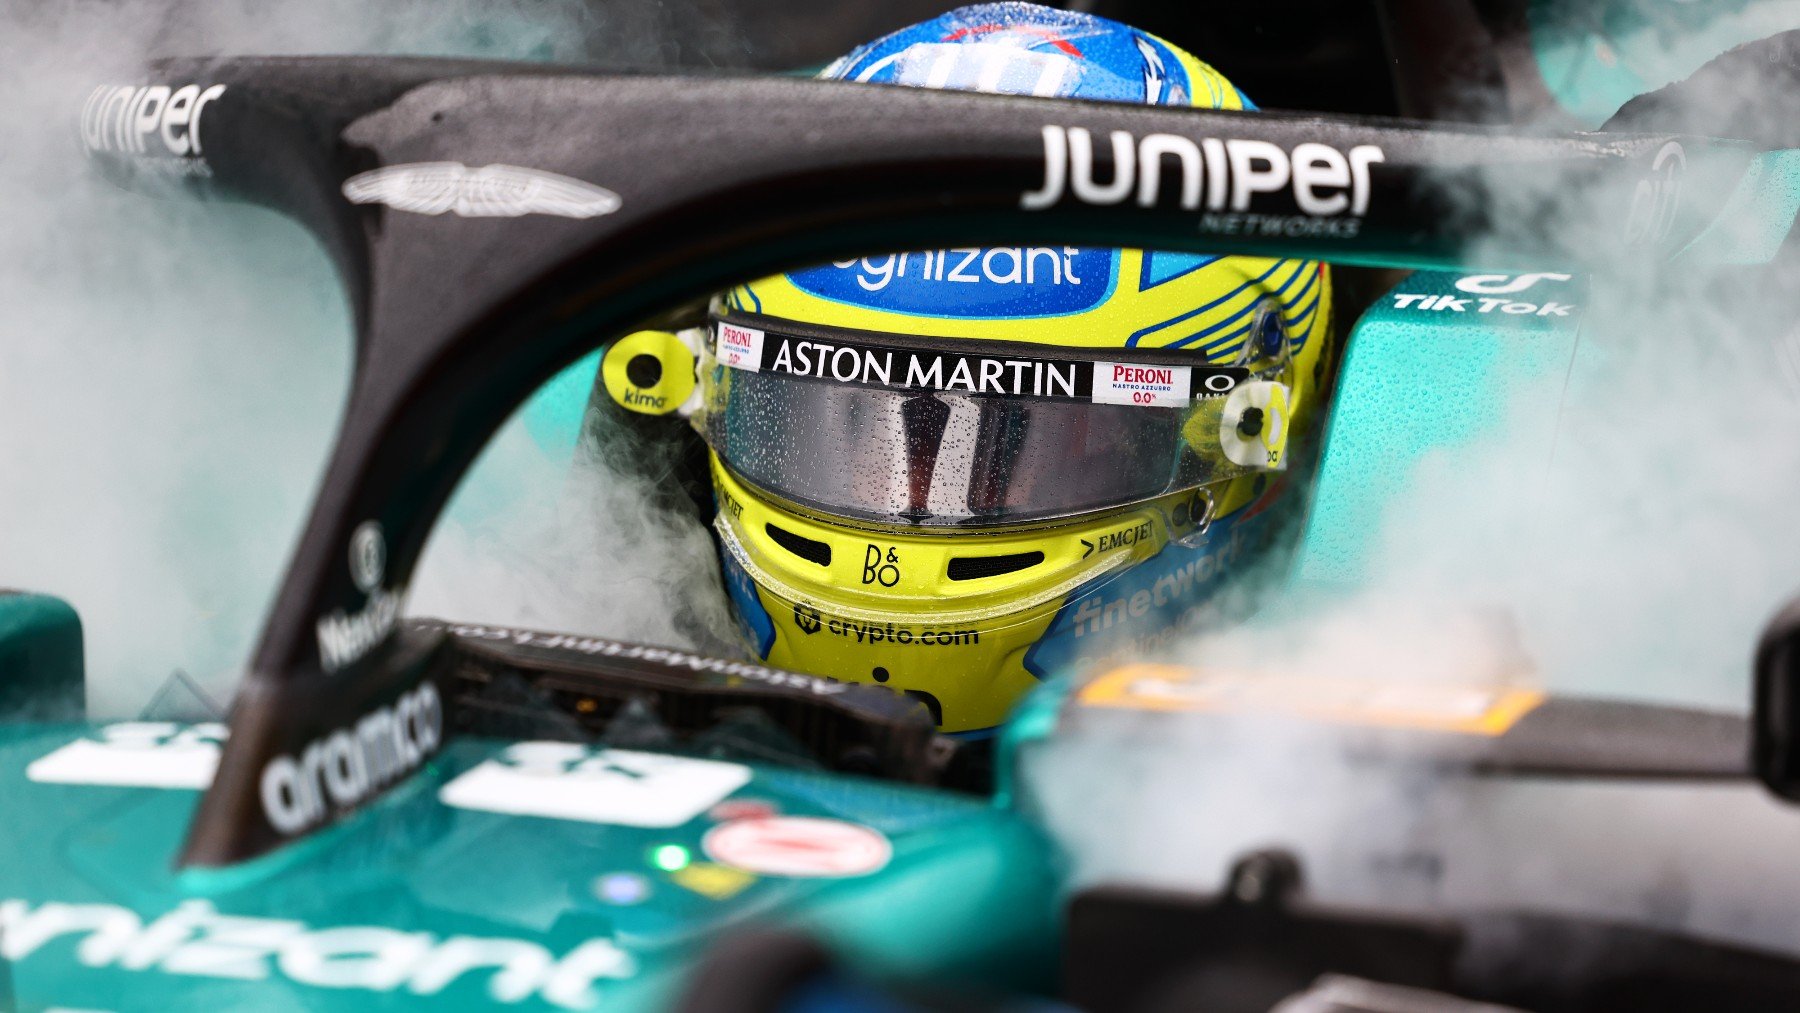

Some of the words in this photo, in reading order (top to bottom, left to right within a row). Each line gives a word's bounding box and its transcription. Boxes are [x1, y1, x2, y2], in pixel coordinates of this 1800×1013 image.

[832, 246, 1081, 292] gnizant
[723, 326, 752, 348] PERONI
[771, 339, 893, 385] ASTON
[904, 354, 1076, 398] MARTIN
[1113, 365, 1173, 385] PERONI
[1112, 383, 1140, 391] NASTRO
[1141, 384, 1171, 392] AZZURRO
[1098, 519, 1154, 553] EMCJET
[828, 618, 980, 646] crypto.com
[0, 898, 638, 1011] nizant
